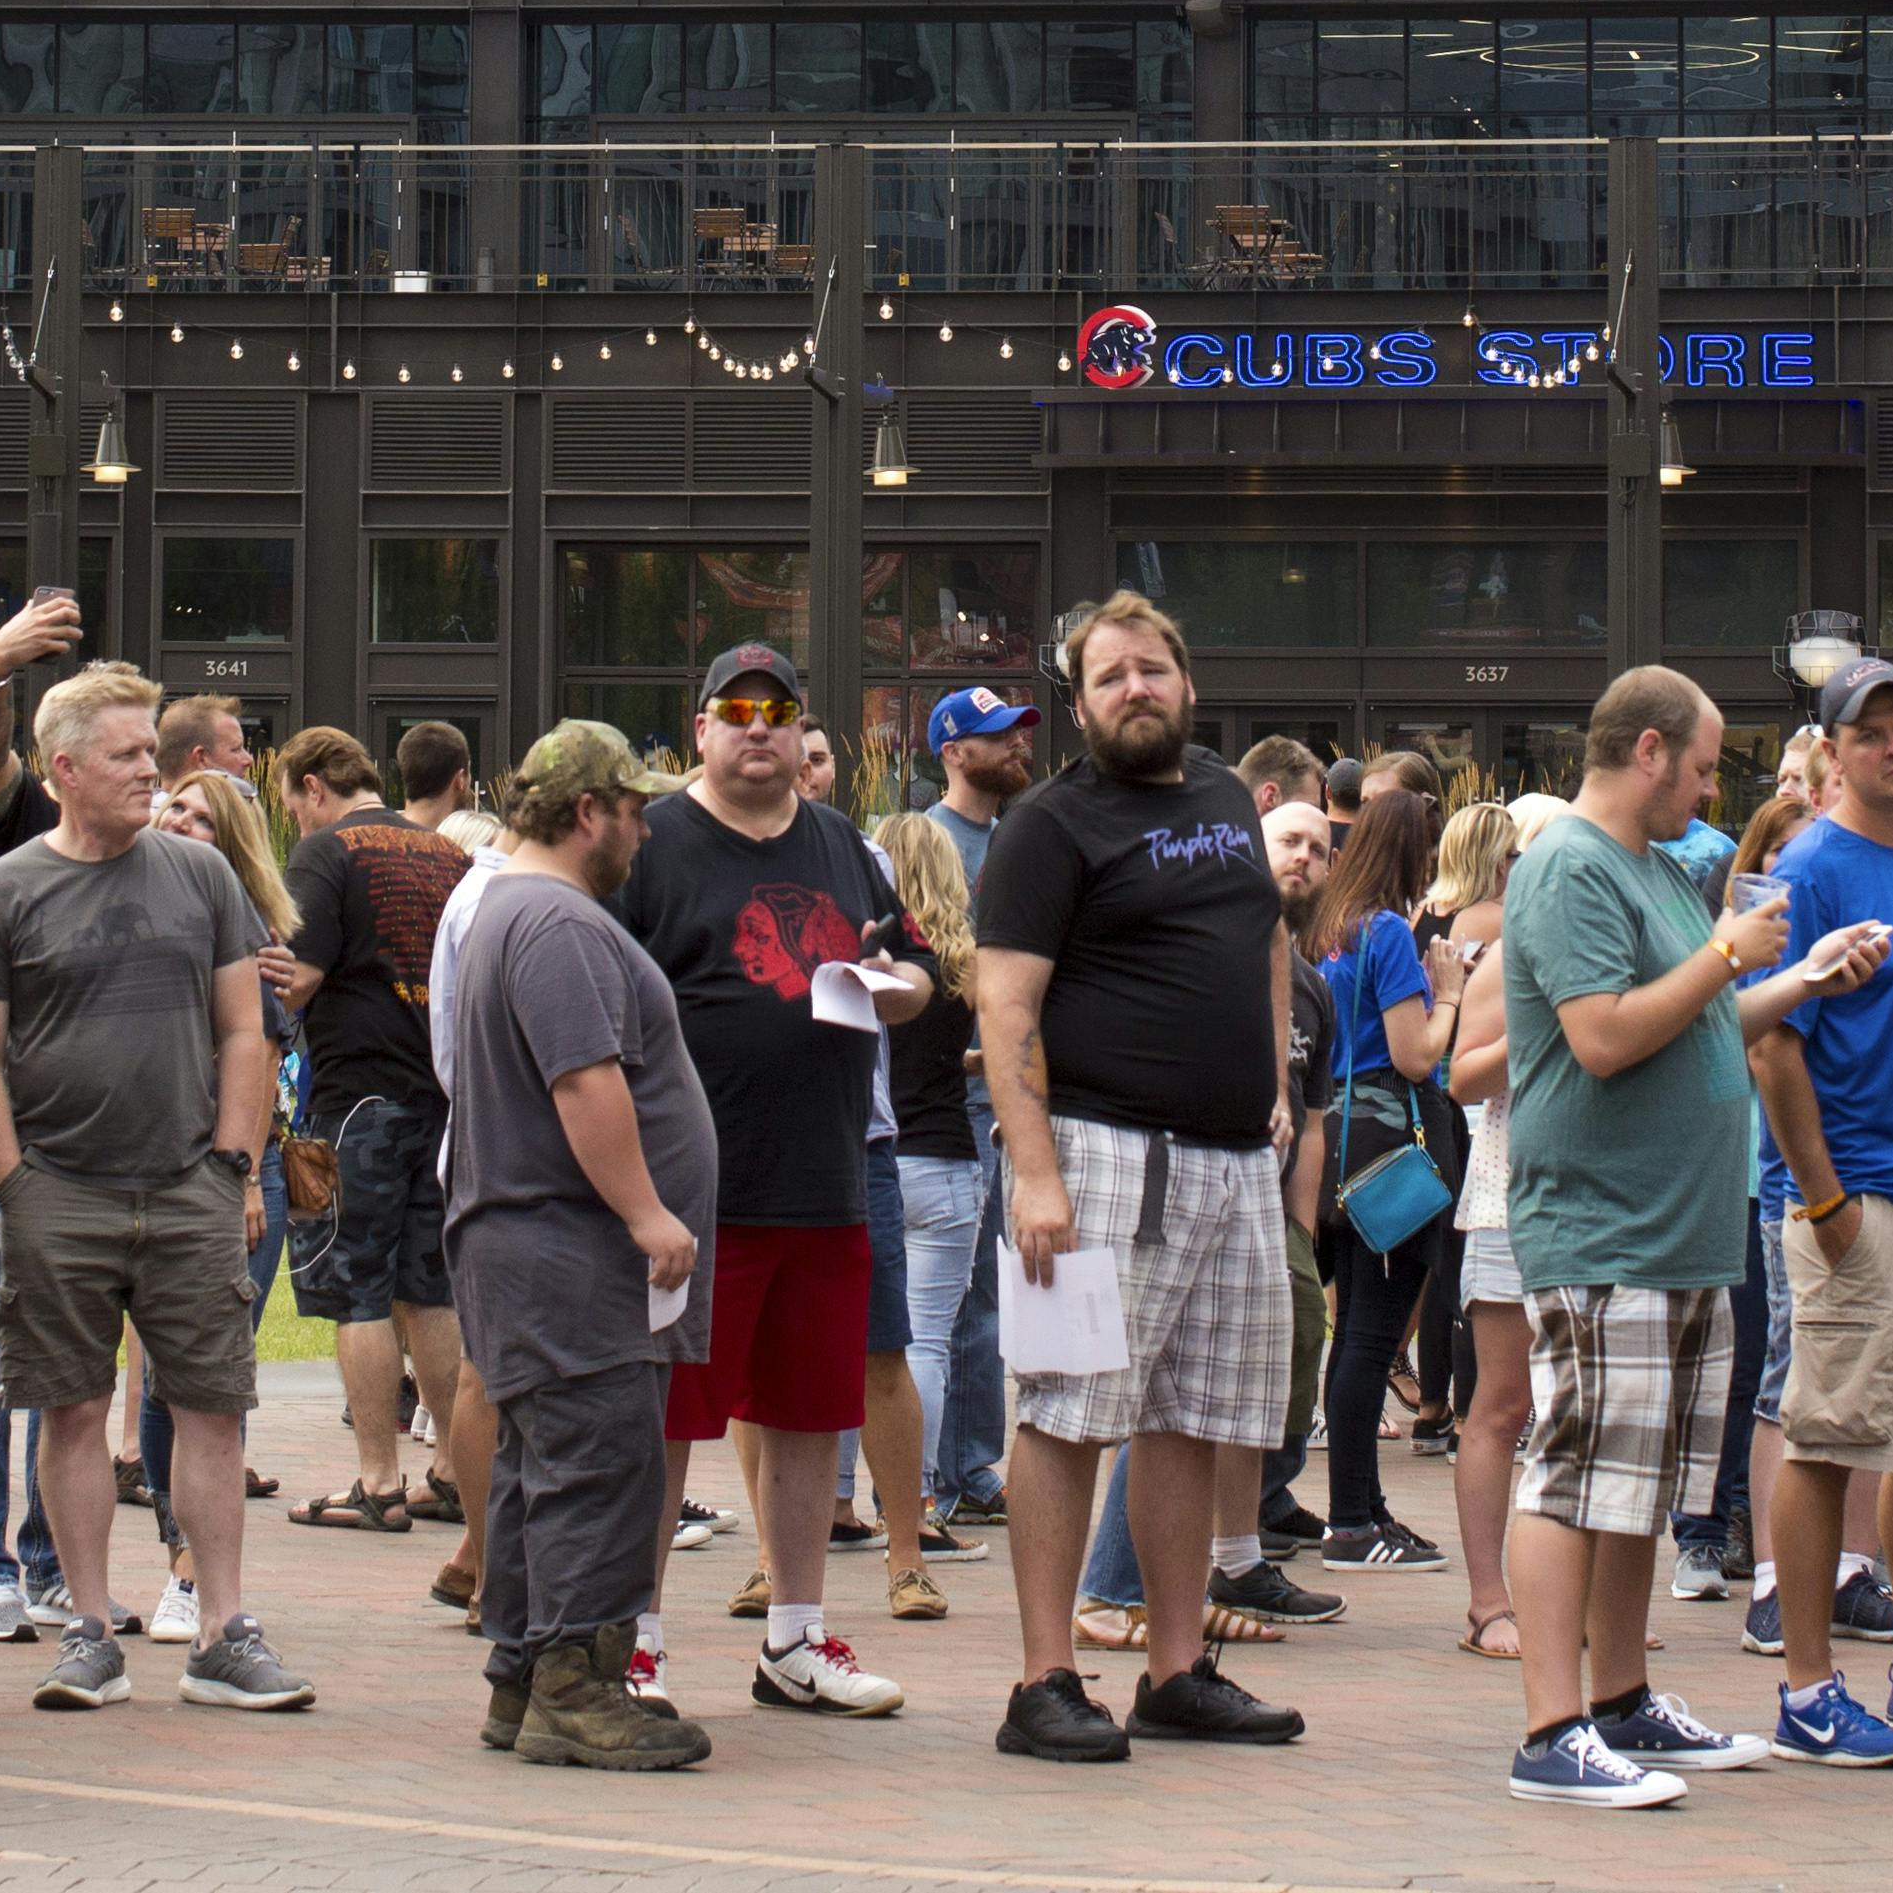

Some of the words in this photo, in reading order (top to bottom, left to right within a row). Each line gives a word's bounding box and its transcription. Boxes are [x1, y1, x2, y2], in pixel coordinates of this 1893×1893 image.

[1163, 331, 1438, 388] CUBS
[1477, 330, 1816, 388] STRE
[205, 660, 248, 676] 3641
[1465, 666, 1510, 682] 3637
[1143, 822, 1214, 871] Purple
